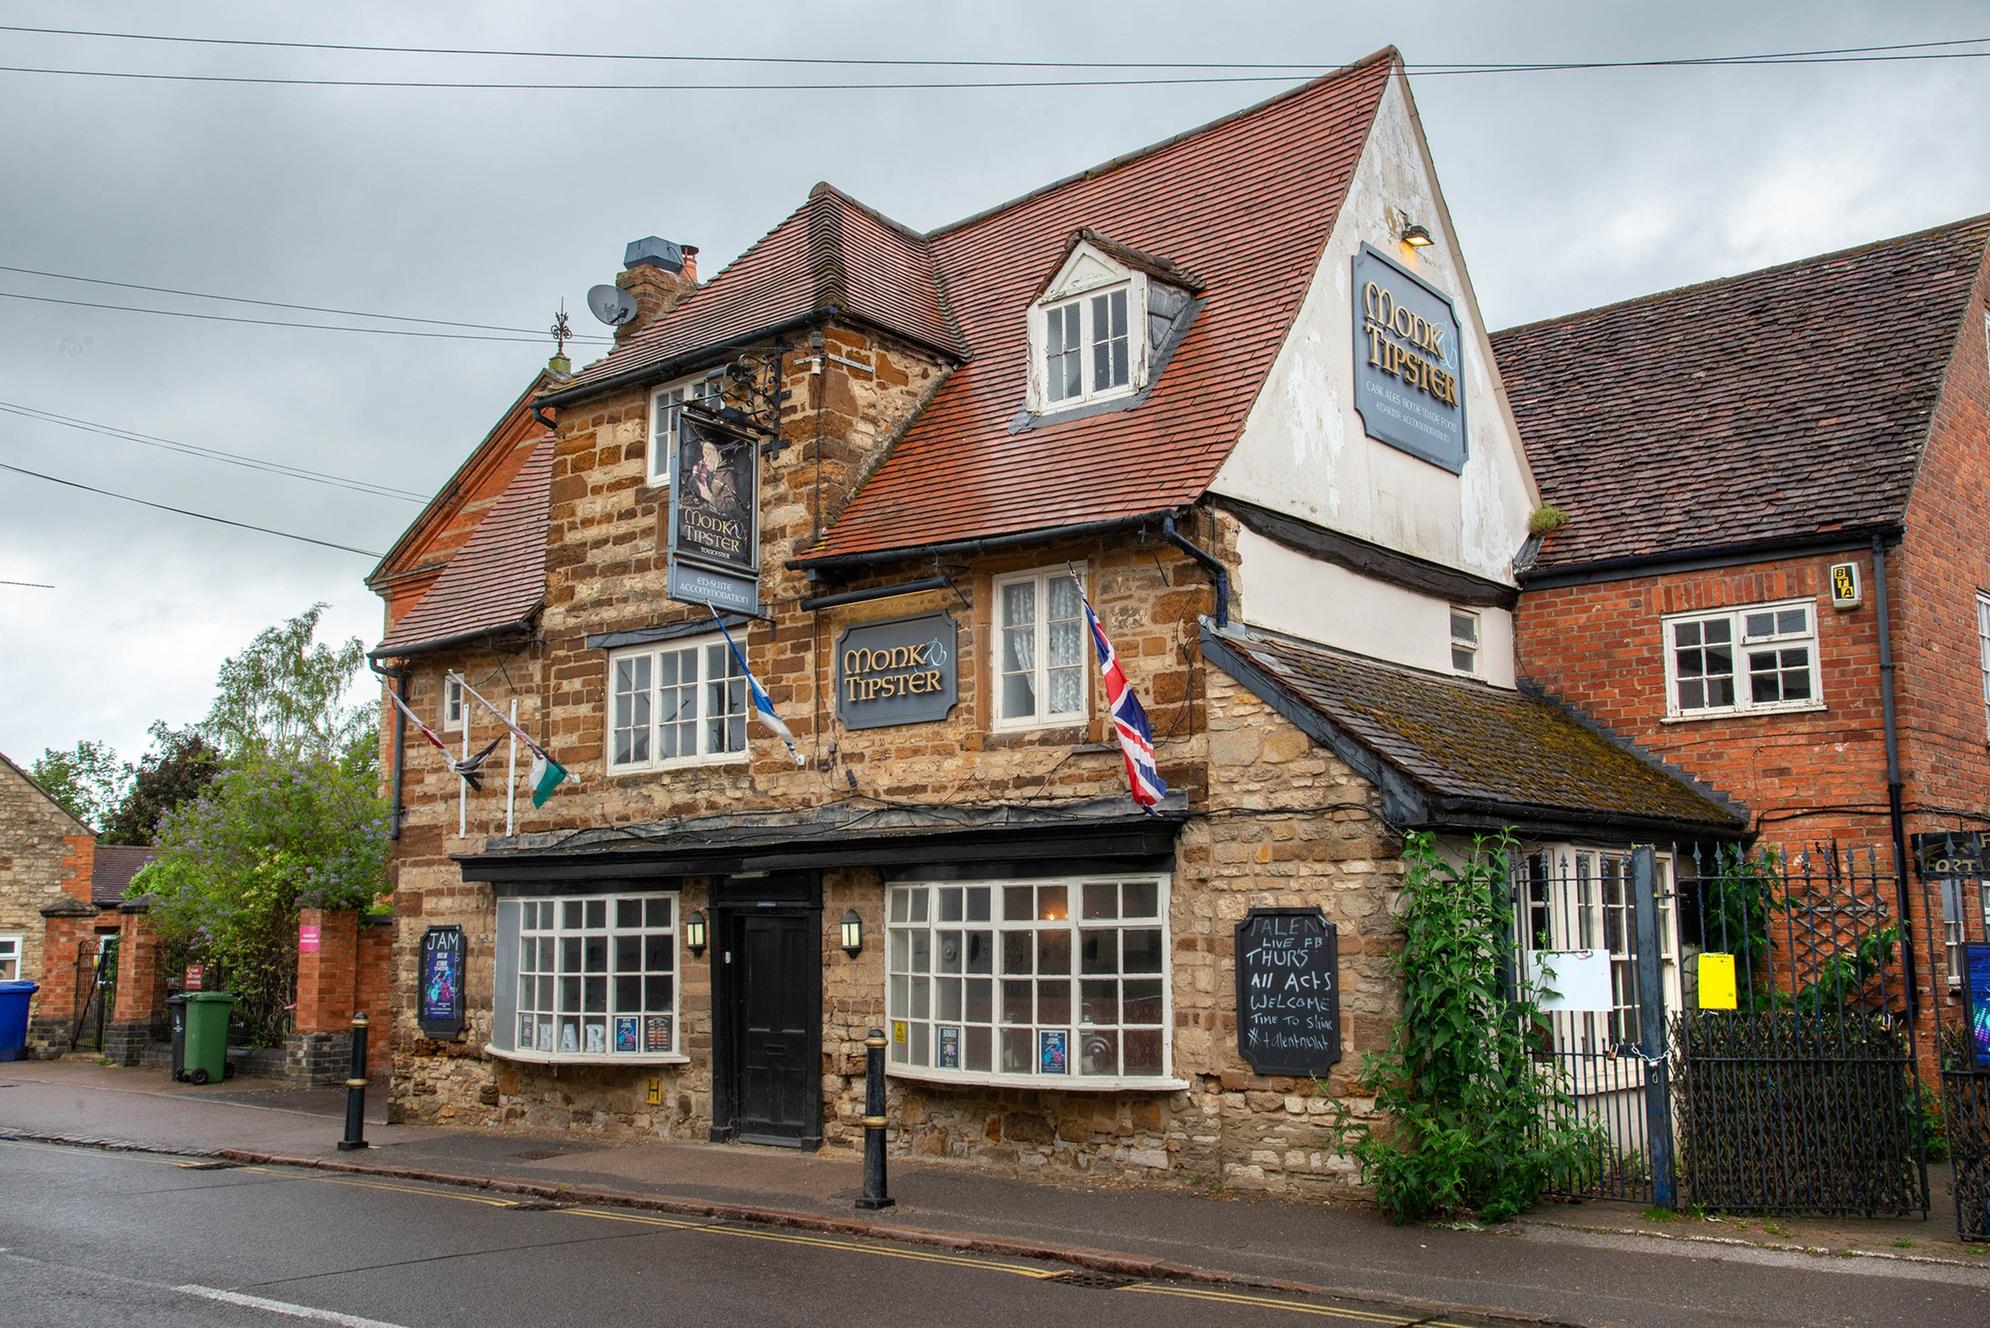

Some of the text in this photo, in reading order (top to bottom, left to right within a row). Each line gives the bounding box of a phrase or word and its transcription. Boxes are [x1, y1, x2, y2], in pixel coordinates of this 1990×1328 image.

[1364, 322, 1459, 409] TIPSTER
[1366, 380, 1383, 397] CASK
[1384, 390, 1401, 404] ALES
[684, 524, 740, 553] TIPSTER
[680, 582, 749, 605] ACCOMMODATION
[697, 576, 733, 592] EN-SUITE
[844, 669, 943, 703] TIPSTER
[427, 931, 459, 952] JAM
[1262, 937, 1323, 949] LIVE FB
[1250, 993, 1331, 1013] WELCOME
[1250, 1012, 1279, 1026] TIME
[1283, 1015, 1300, 1026] TO
[538, 1023, 606, 1053] BAR
